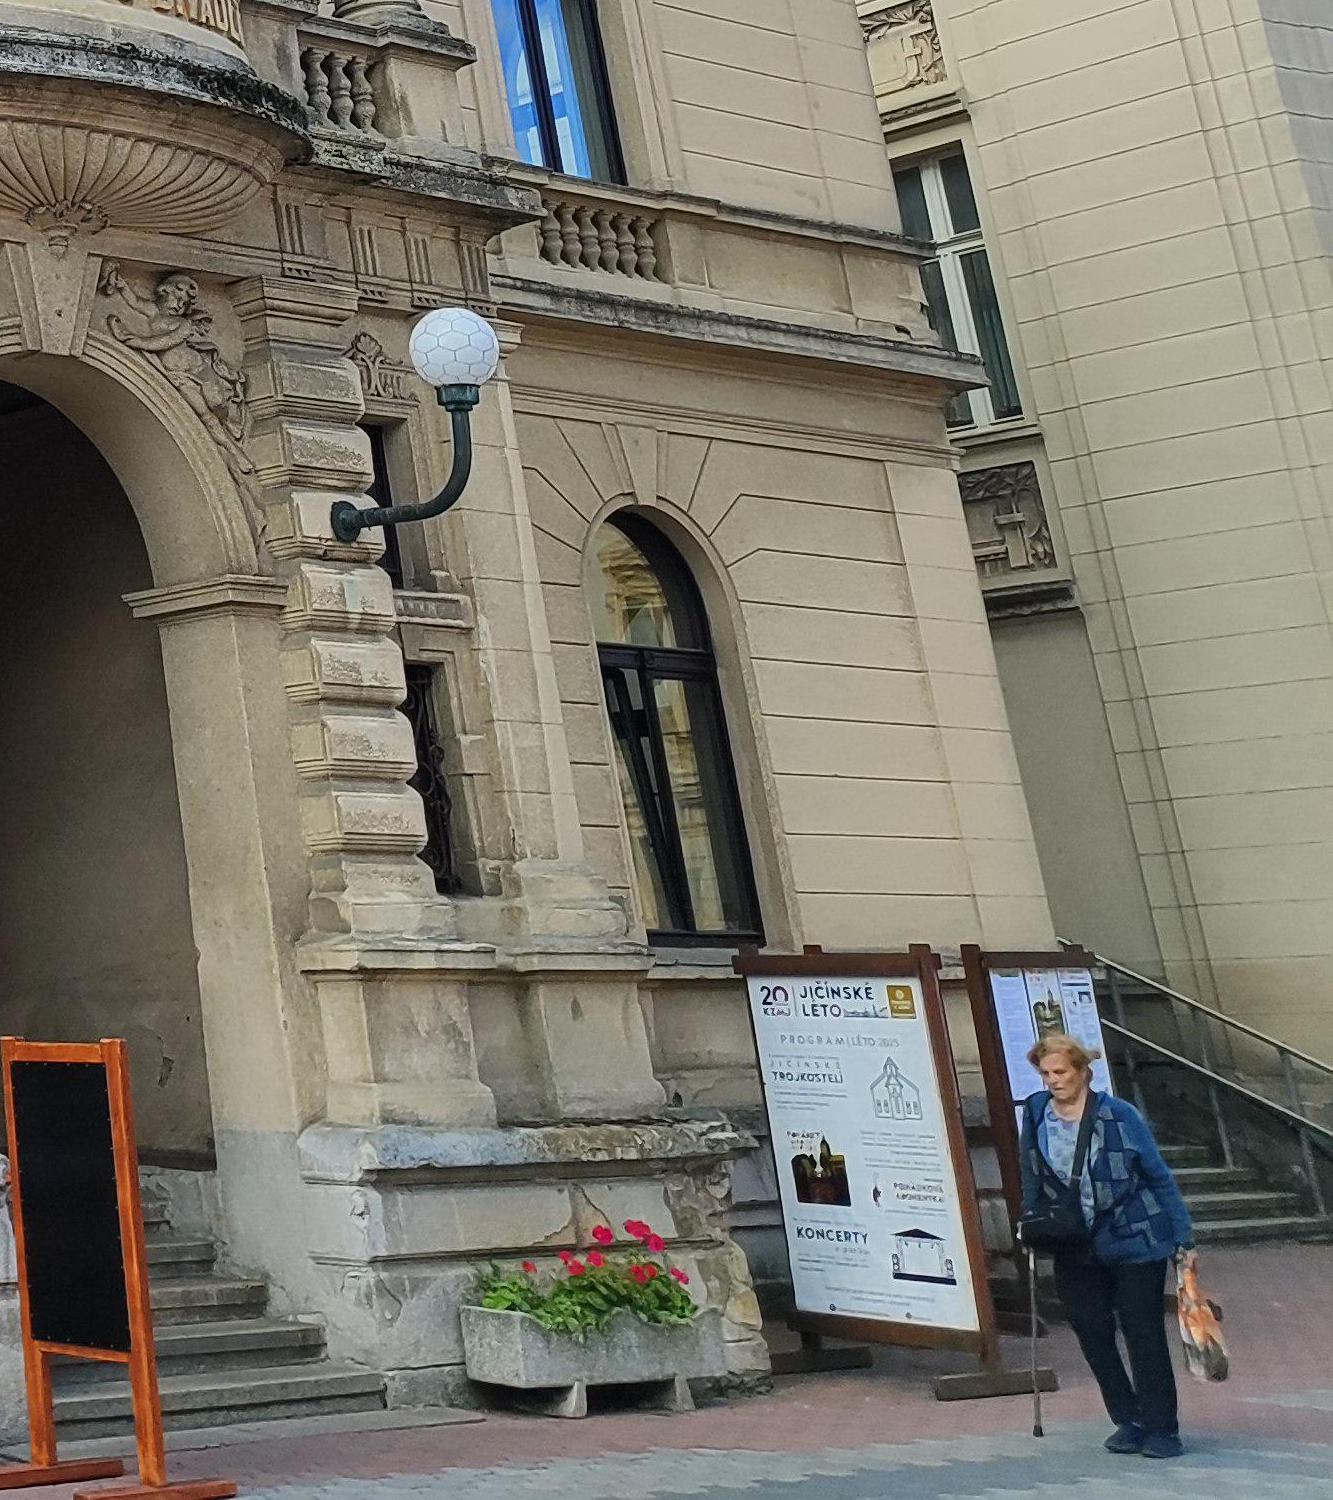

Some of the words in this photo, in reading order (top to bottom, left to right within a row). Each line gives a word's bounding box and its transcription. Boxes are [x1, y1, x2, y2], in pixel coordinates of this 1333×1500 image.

[760, 985, 790, 1006] 20
[799, 980, 875, 1001] JIČÍNSKÉ
[796, 1226, 869, 1245] KONCERTY
